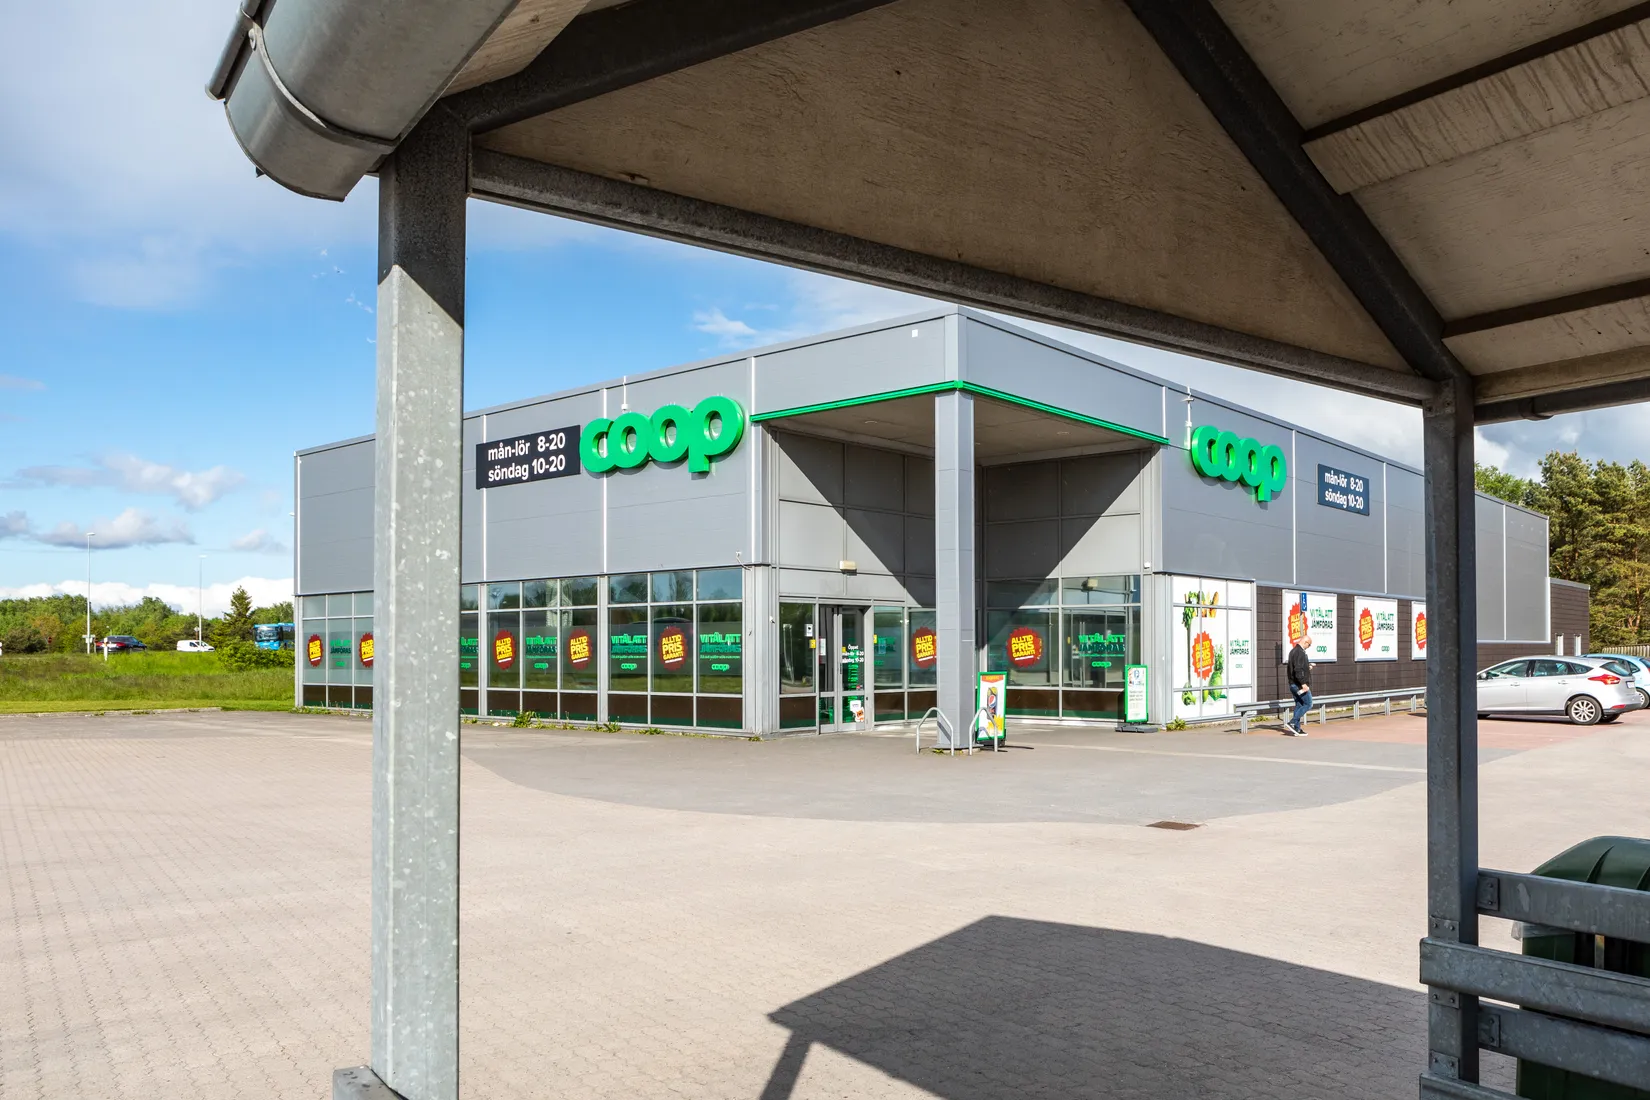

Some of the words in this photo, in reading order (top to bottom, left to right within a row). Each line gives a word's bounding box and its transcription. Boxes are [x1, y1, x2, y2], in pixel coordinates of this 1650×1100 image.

[579, 396, 743, 473] coop
[487, 440, 531, 461] mån-lör
[537, 432, 566, 452] 8-20
[488, 462, 529, 482] söndag
[531, 454, 566, 475] 10-20
[1191, 425, 1287, 502] coop
[1324, 470, 1348, 488] mån-lör
[1350, 477, 1364, 493] 8-20
[1325, 488, 1347, 509] söndag
[1347, 493, 1364, 510] 10-20
[1312, 619, 1334, 629] JÄMFÖRAS
[570, 636, 586, 646] ALLTID
[662, 635, 682, 645] ALLTID
[916, 636, 932, 645] ALLTID
[1012, 635, 1032, 645] ALLTID
[496, 644, 512, 656] PRIS
[572, 643, 588, 655] PRIS
[662, 643, 682, 655] PRIS
[916, 643, 932, 654] PRIS
[1012, 642, 1034, 653] PRIS
[1012, 650, 1034, 658] GARANTI
